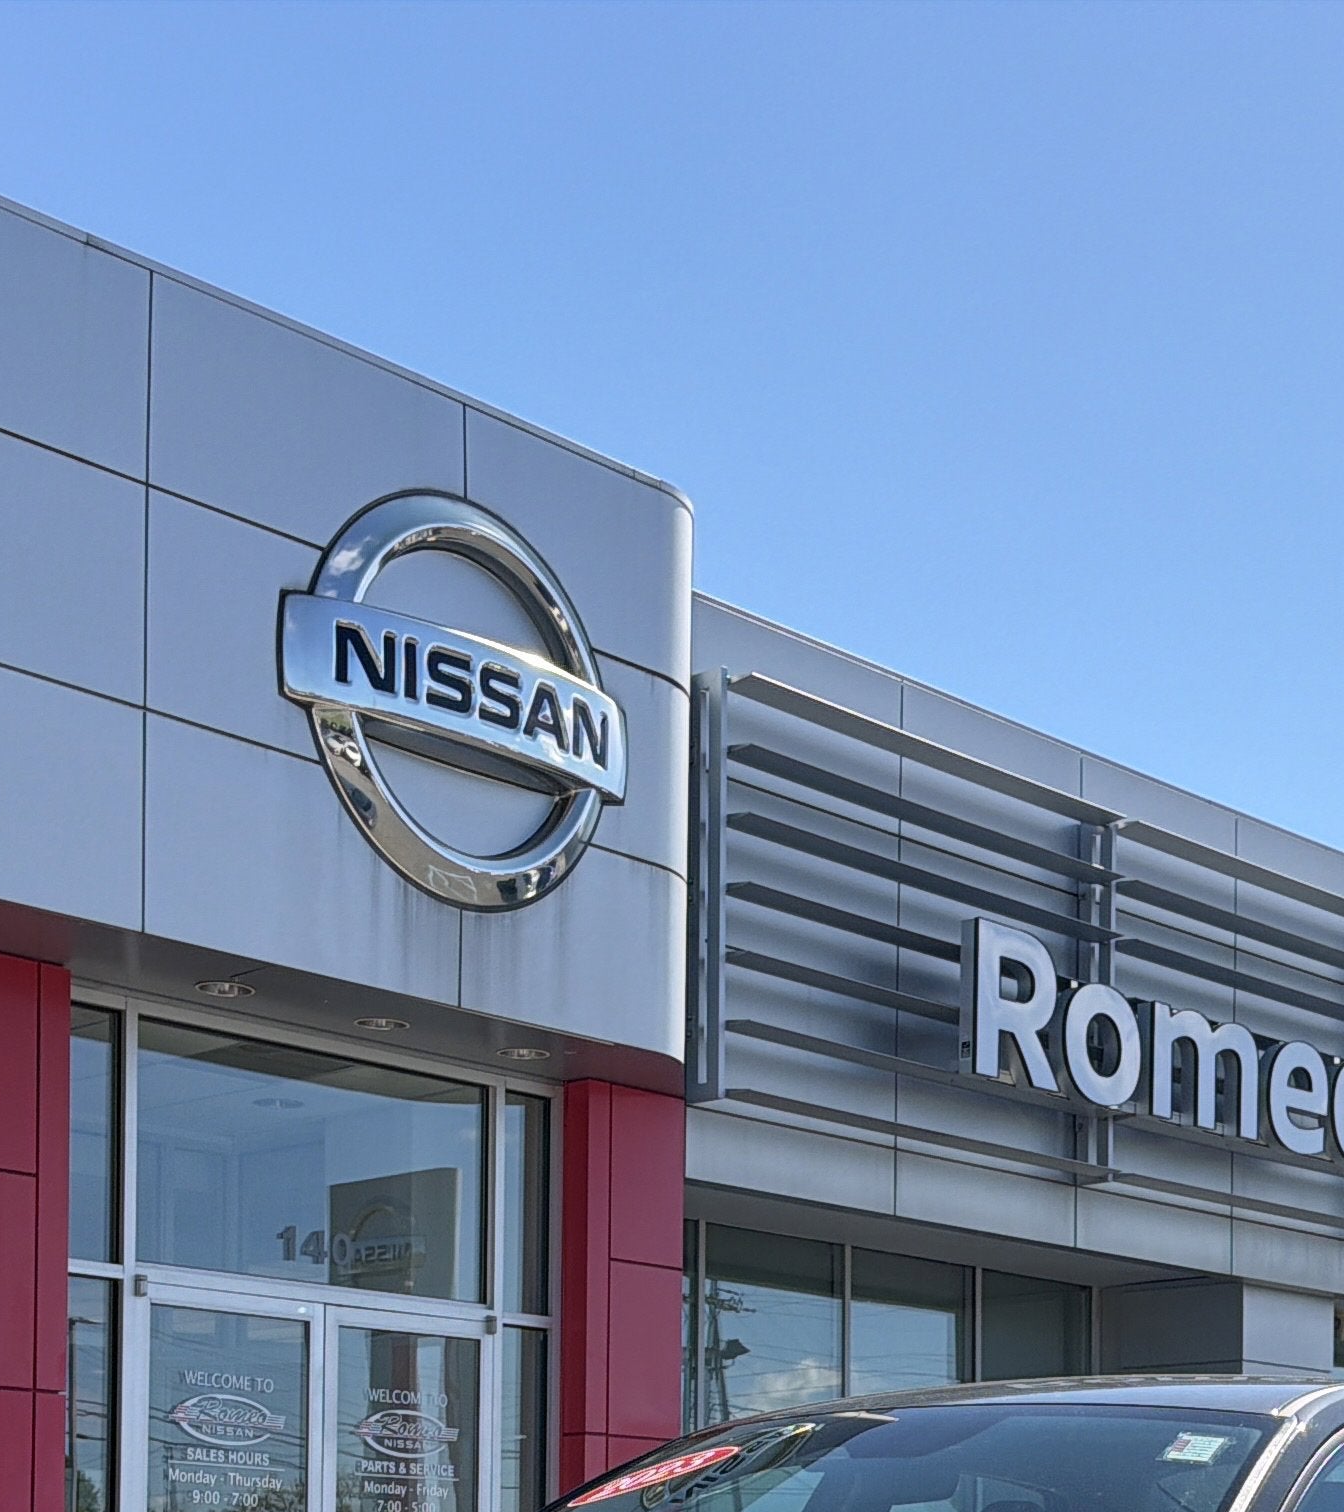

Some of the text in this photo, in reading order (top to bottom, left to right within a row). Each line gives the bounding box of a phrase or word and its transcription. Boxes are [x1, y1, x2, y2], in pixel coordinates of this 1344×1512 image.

[332, 618, 610, 772] NISSAN
[276, 1225, 351, 1266] 140
[184, 1369, 274, 1394] WELCOME TO
[367, 1387, 429, 1405] WELCOM
[202, 1423, 254, 1438] NISSAN
[383, 1438, 431, 1451] NISSA
[186, 1447, 270, 1466] SALES HOURS
[360, 1460, 455, 1477] PARTS & SERVICE
[167, 1467, 217, 1487] Monday
[228, 1472, 283, 1491] Thursday
[192, 1489, 220, 1505] 9:00
[231, 1492, 259, 1507] 7:00
[363, 1480, 408, 1498] Monday
[416, 1483, 449, 1499] Friday
